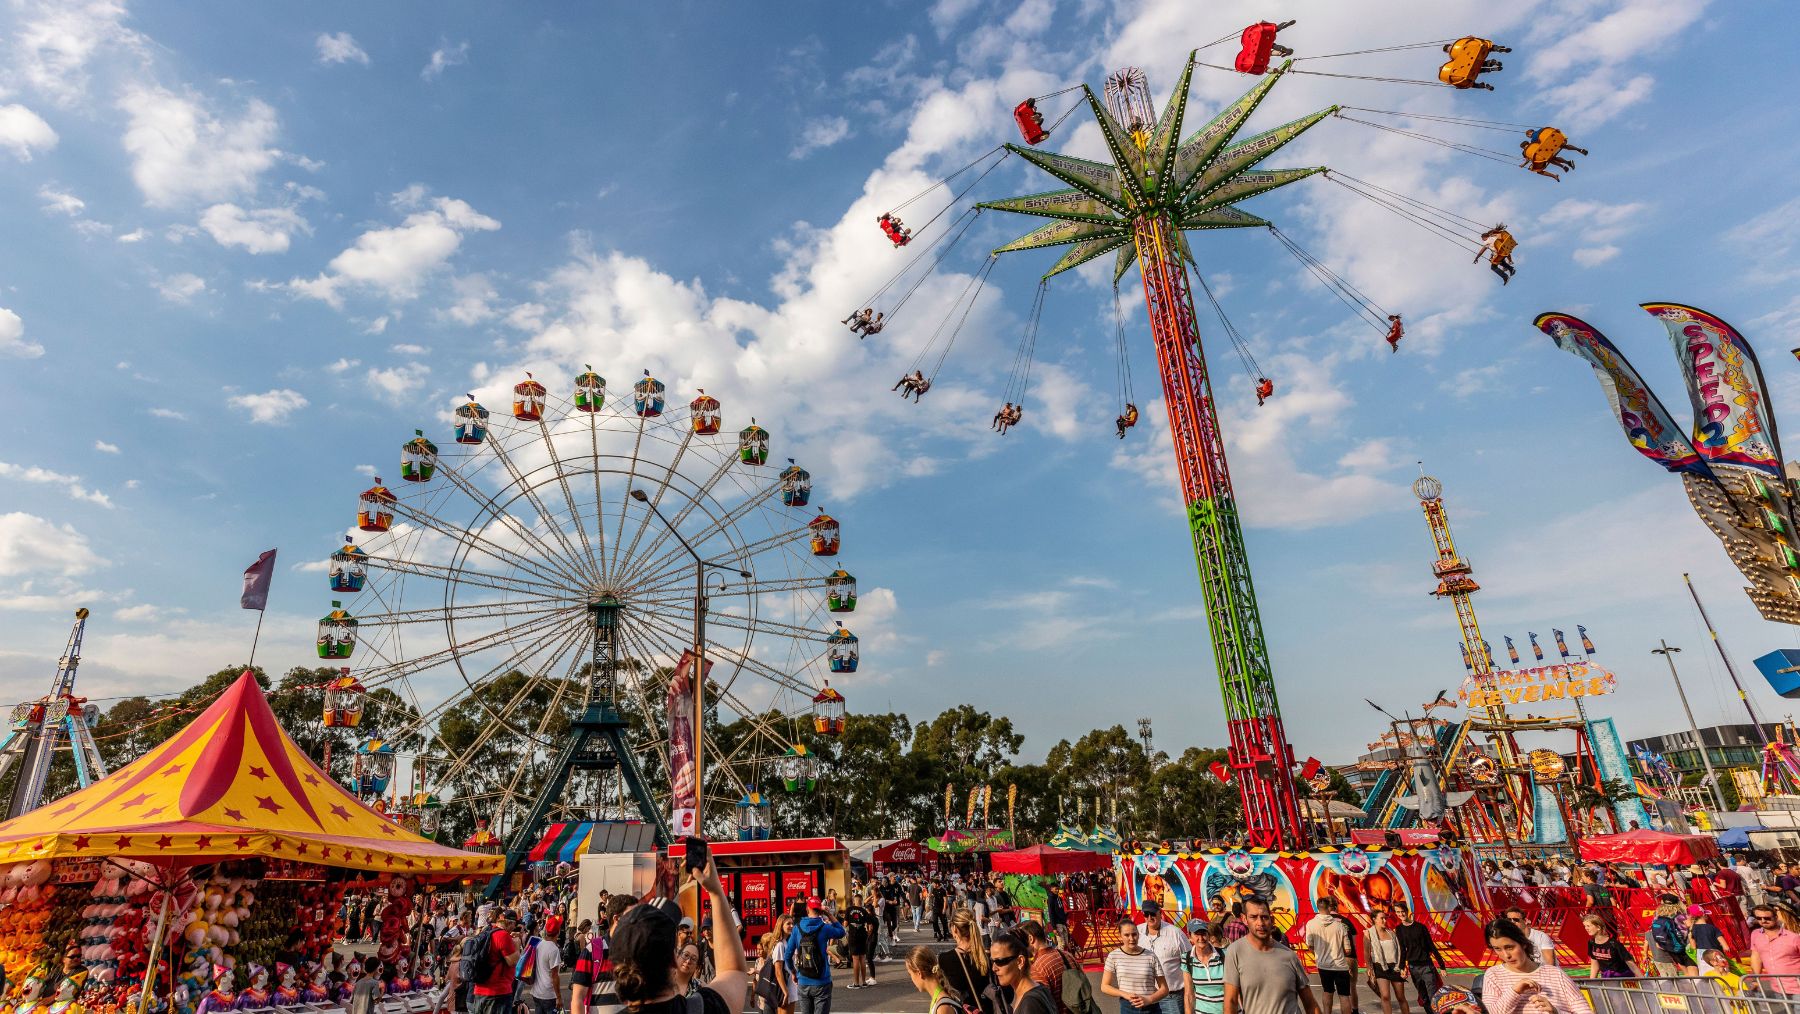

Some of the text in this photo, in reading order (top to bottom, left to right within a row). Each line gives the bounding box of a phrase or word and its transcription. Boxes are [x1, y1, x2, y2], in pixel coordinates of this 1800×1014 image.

[1180, 106, 1244, 160] SKY FLYER
[1231, 134, 1278, 159] FLYER
[1051, 158, 1112, 181] SKY FLYER
[1024, 197, 1051, 209] SKY
[1683, 325, 1730, 448] SPEED 2
[1472, 661, 1590, 688] PIRATES
[1468, 677, 1606, 708] REVENGE
[892, 847, 916, 861] Coca-Cola
[745, 883, 765, 892] Coca-Cola
[787, 881, 807, 890] Coca-Cola
[1438, 992, 1465, 1008] NERF
[1661, 995, 1681, 1004] TFH
